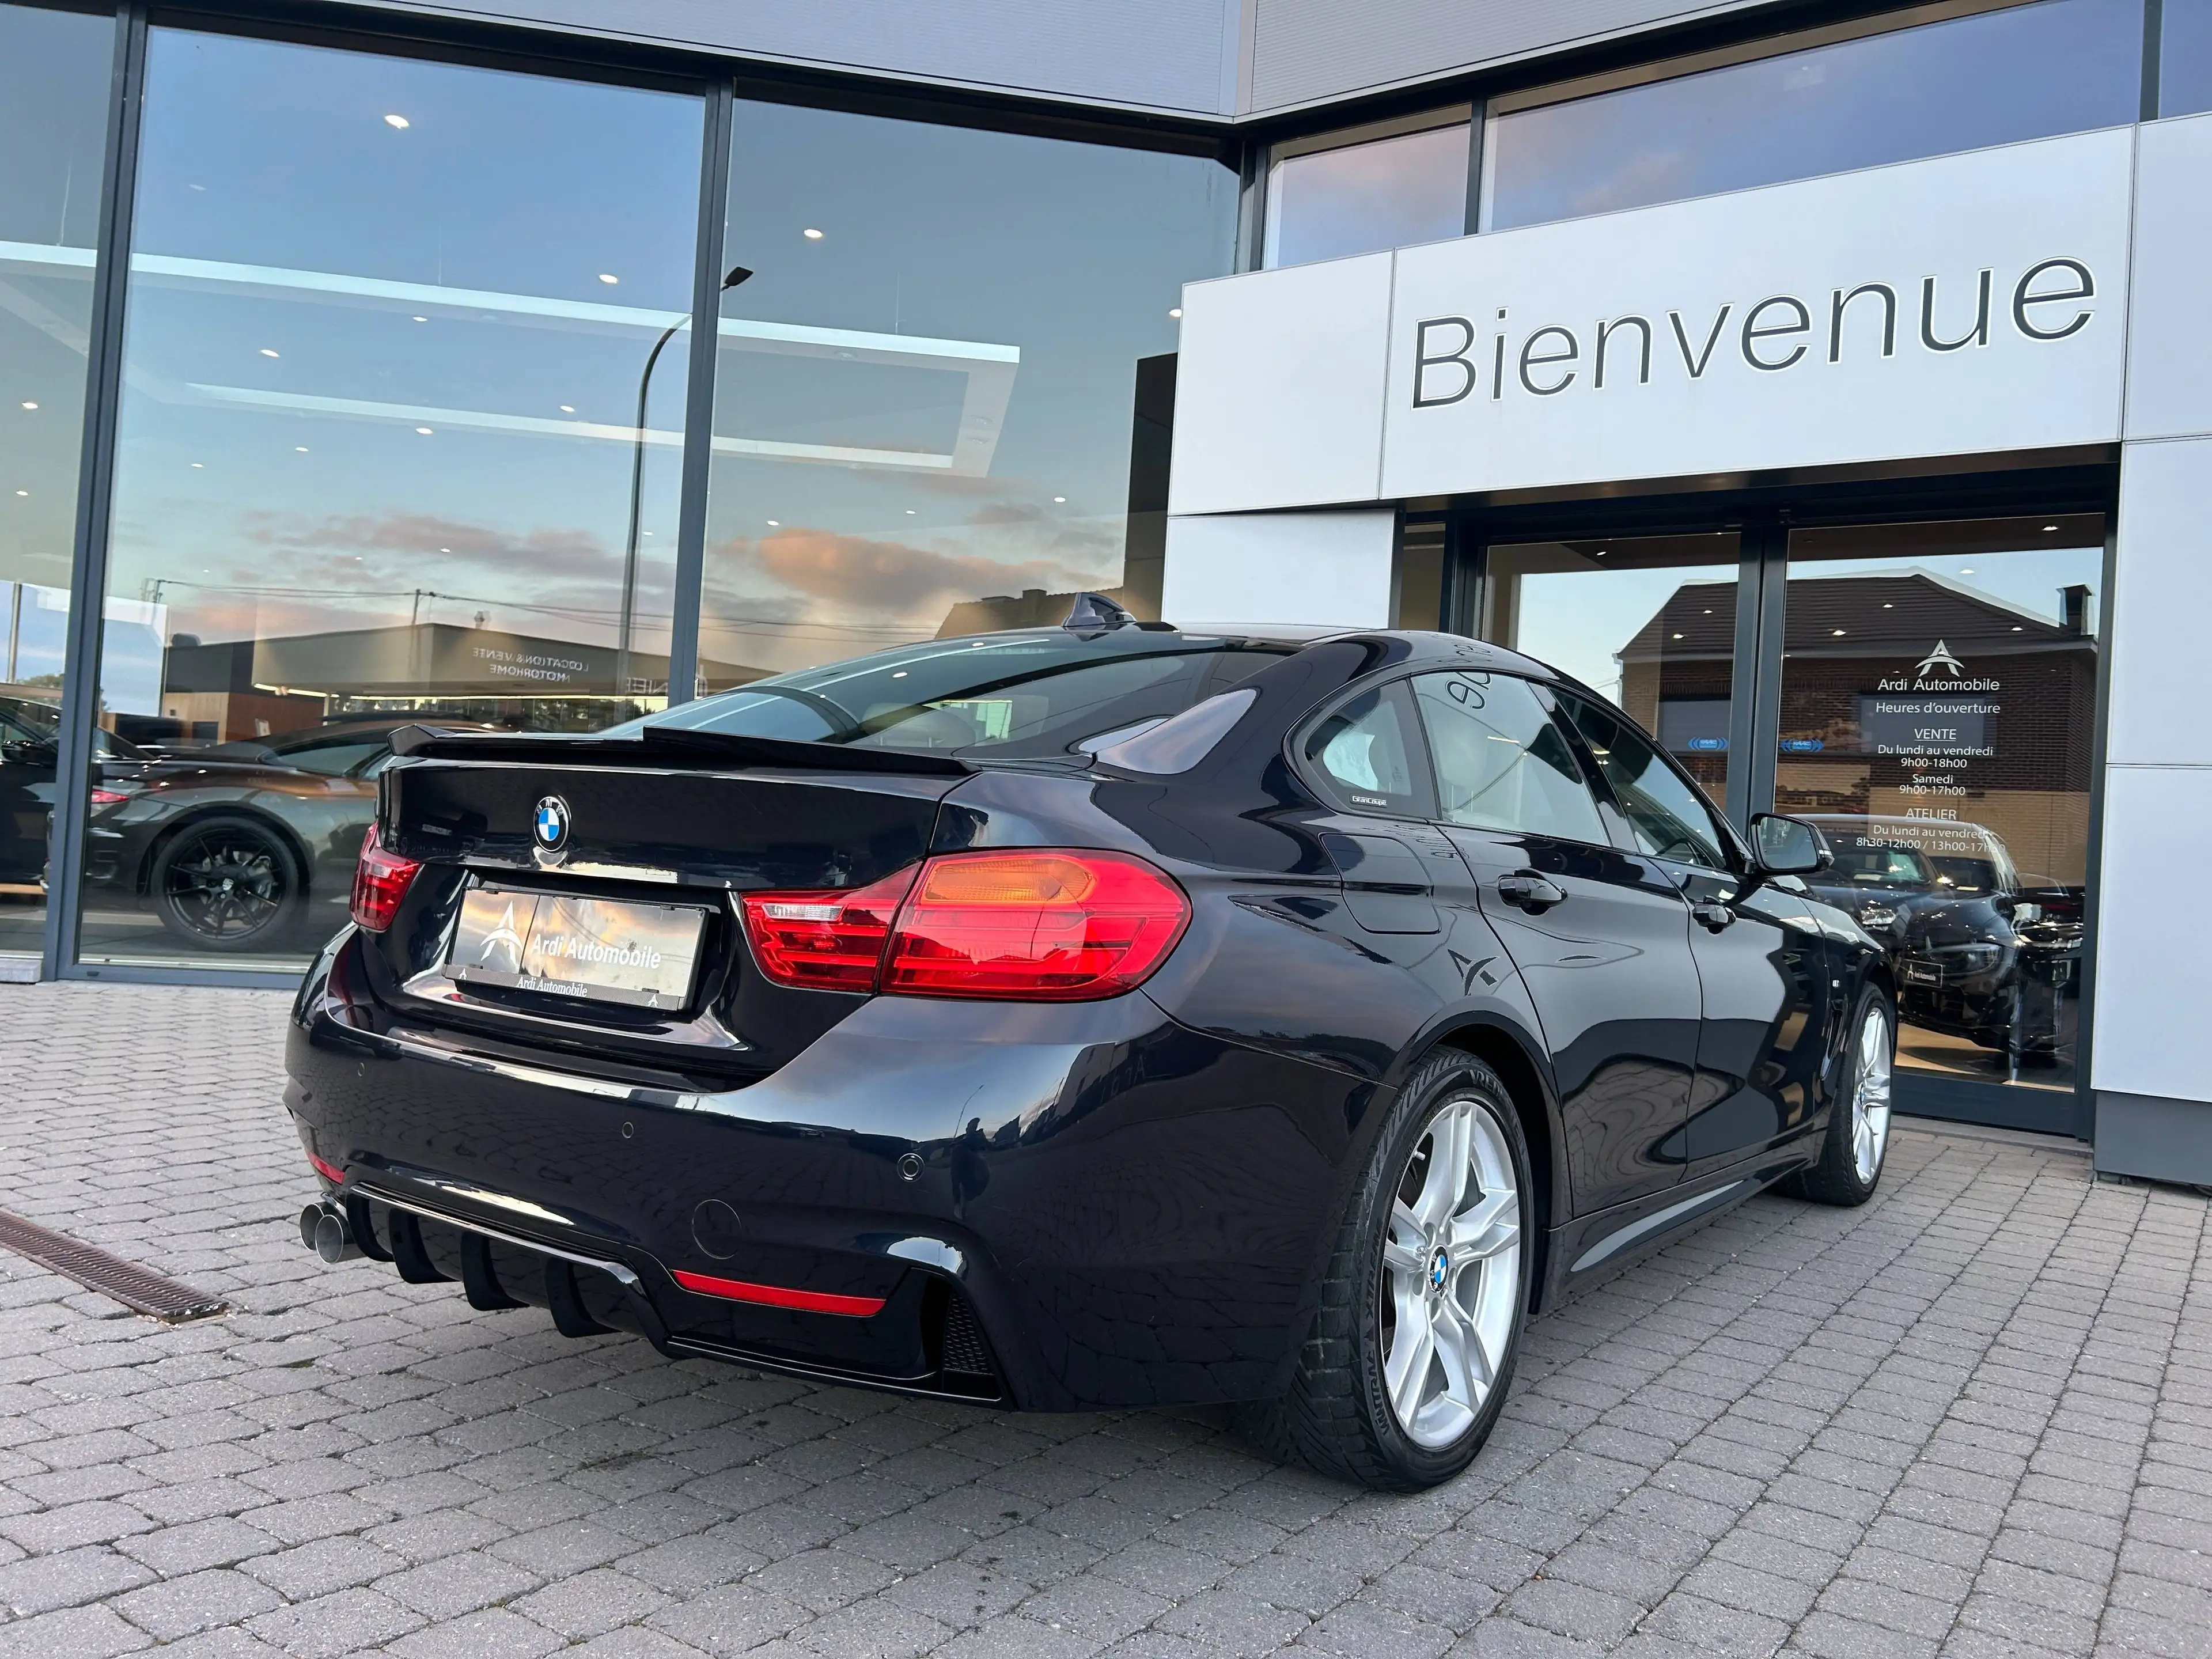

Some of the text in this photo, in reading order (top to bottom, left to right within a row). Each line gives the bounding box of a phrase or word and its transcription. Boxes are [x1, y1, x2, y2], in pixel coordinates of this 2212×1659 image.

[1411, 255, 2097, 410] Bienvenue
[1877, 678, 2000, 691] Ardi Automobile
[1876, 702, 1921, 714] Heures
[1914, 729, 1957, 740] VENTE
[1878, 745, 1893, 754] Du
[1896, 744, 1924, 755] lundi
[1943, 746, 1993, 756] vendredi
[1901, 758, 1967, 768] 9h00-18h00
[1912, 774, 1953, 784] Samedi
[1899, 785, 1965, 796] 9h00-17h00
[1905, 808, 1957, 820] ATELIER
[1874, 825, 1889, 835] Du
[1892, 825, 1919, 836] lundi
[1938, 827, 1988, 839] vendred
[1856, 837, 1921, 850] 8h30-12h00
[532, 933, 661, 969] Ardi Automobile
[517, 976, 588, 998] Ardi Automobile
